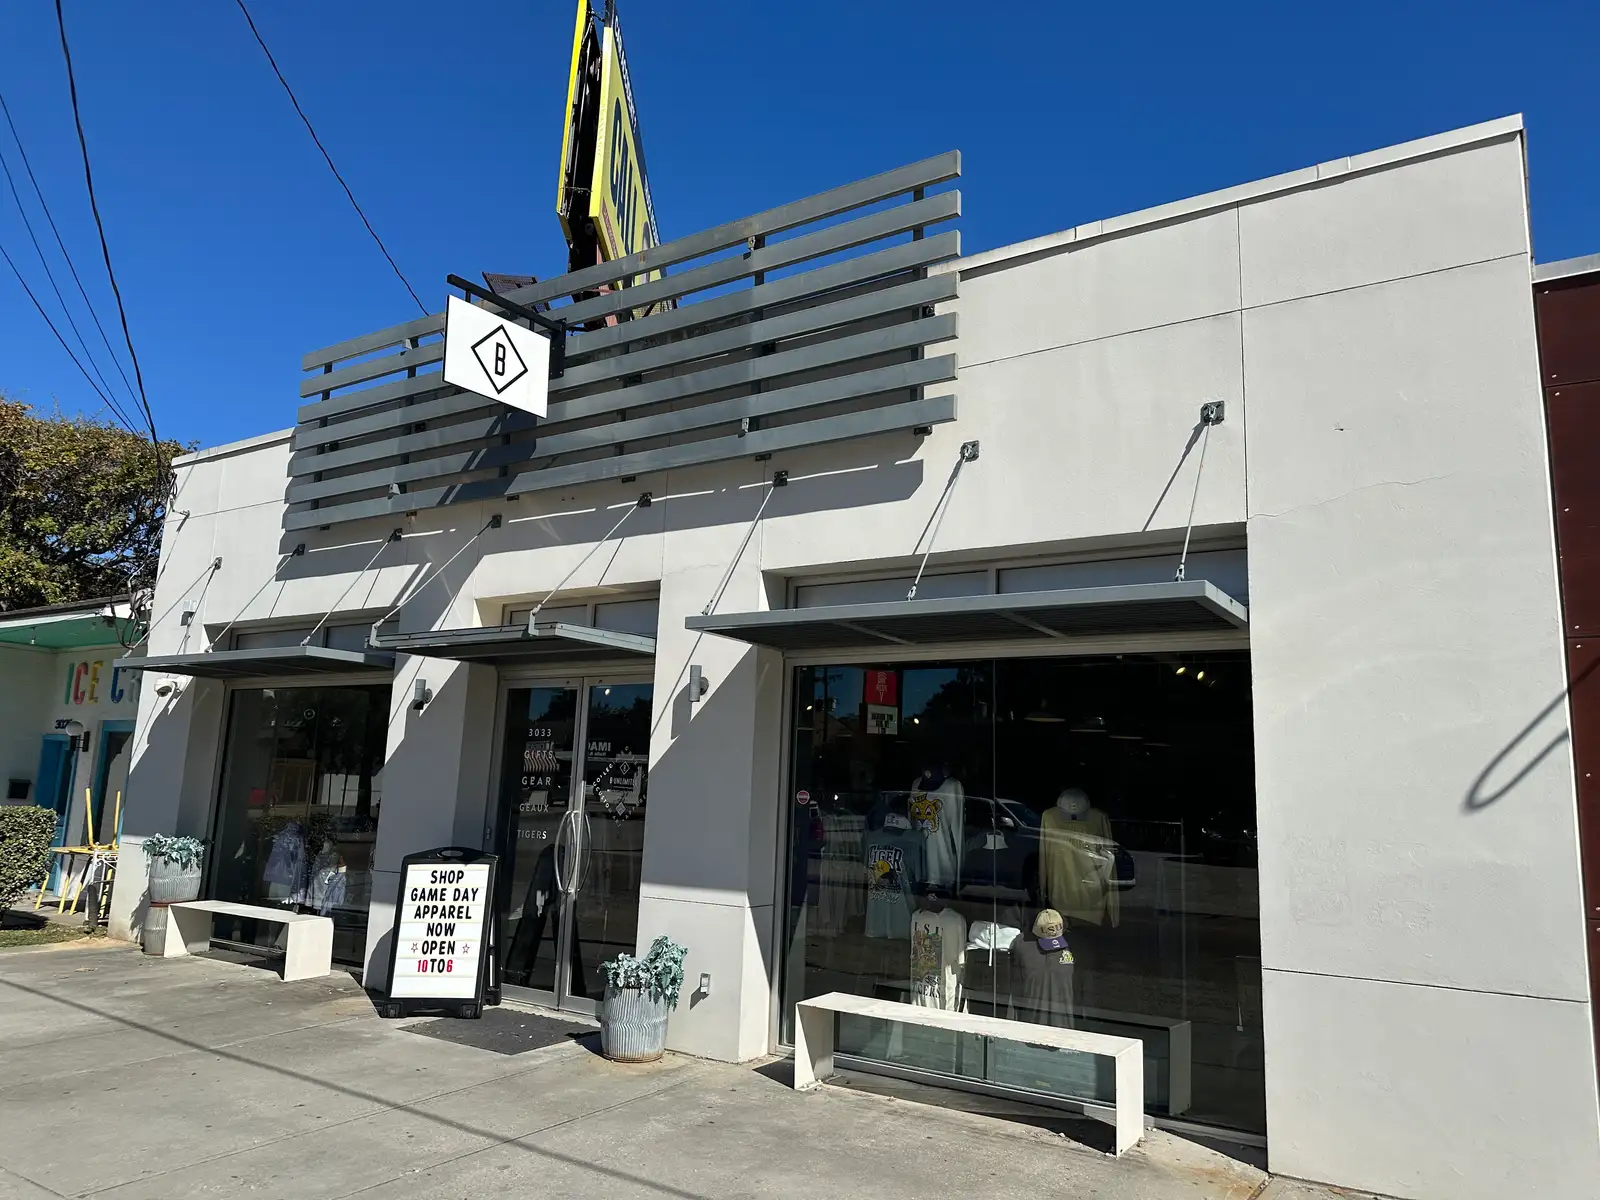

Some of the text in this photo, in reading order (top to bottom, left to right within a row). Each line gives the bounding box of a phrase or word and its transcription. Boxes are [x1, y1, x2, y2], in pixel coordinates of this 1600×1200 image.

[495, 342, 506, 376] B
[64, 660, 104, 705] ICE
[528, 728, 552, 737] 3033
[524, 750, 554, 759] GIFTS
[522, 776, 551, 786] GEAR
[519, 803, 549, 813] GEAUX
[517, 829, 547, 840] TIGERS
[868, 844, 904, 873] TIGER
[430, 870, 465, 884] SHOP
[411, 887, 479, 902] GAME DAY
[414, 905, 472, 919] APPAREL
[426, 922, 456, 937] NOW
[1040, 923, 1063, 934] LSU
[421, 940, 456, 955] OPEN
